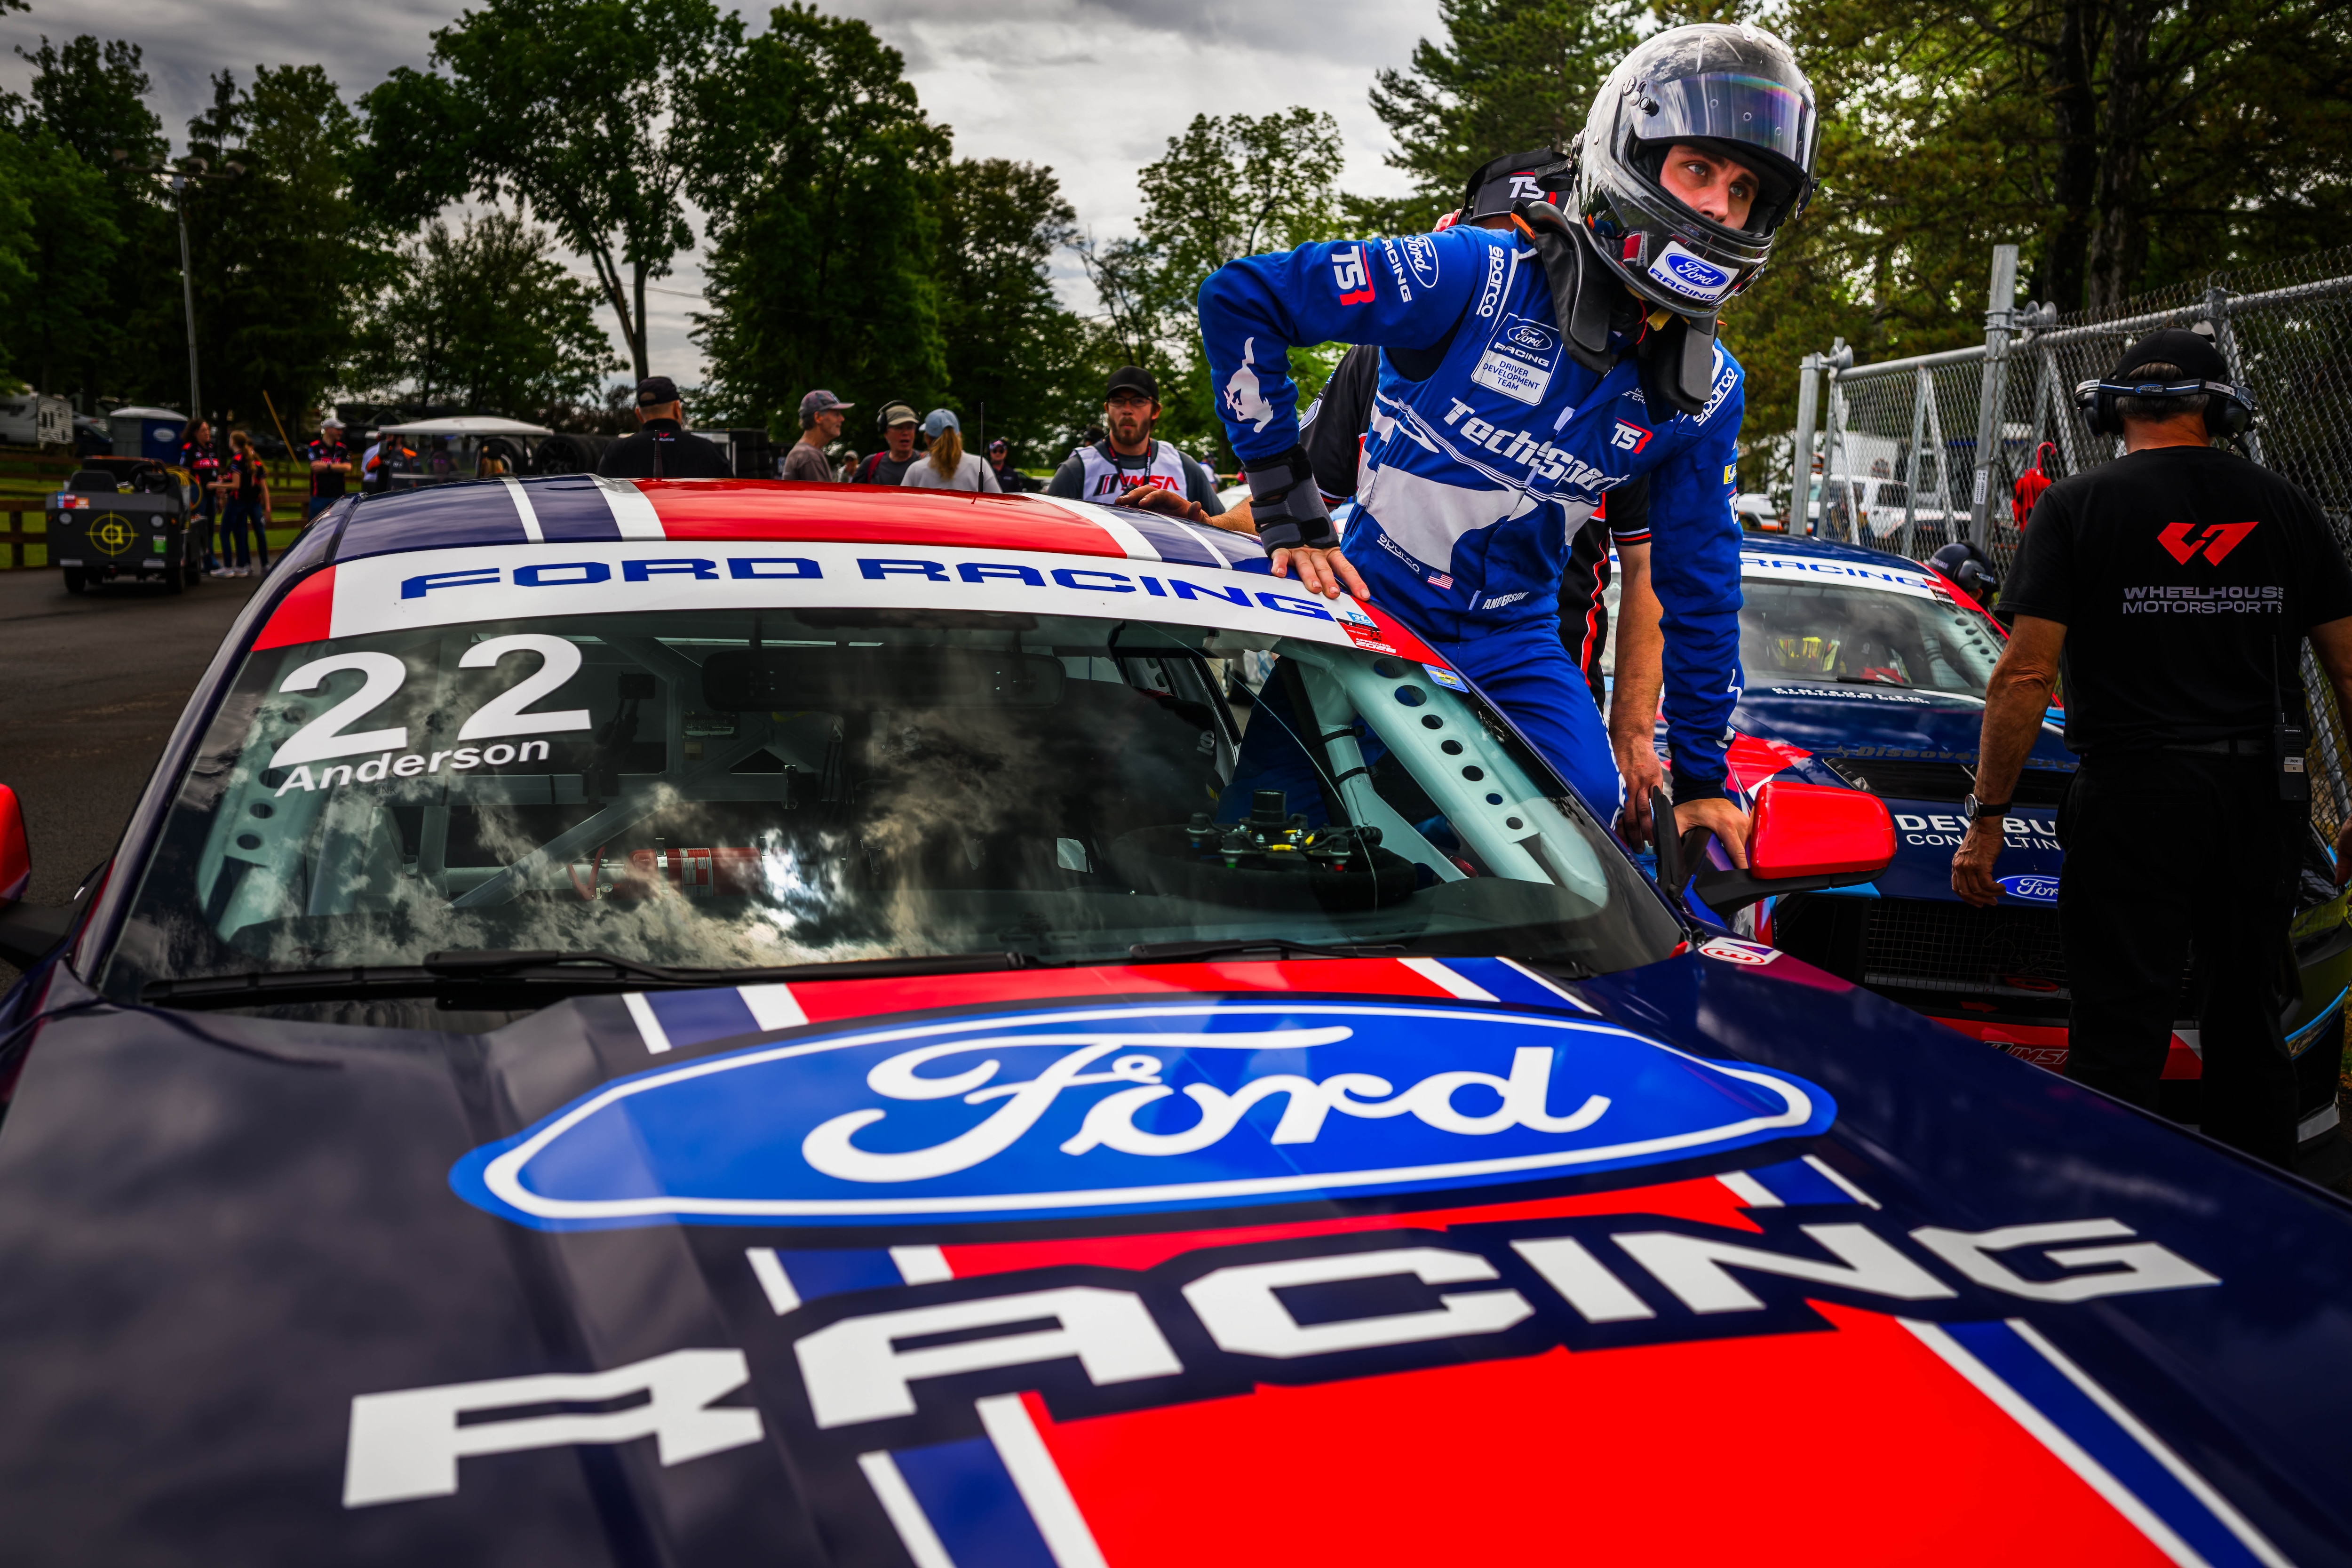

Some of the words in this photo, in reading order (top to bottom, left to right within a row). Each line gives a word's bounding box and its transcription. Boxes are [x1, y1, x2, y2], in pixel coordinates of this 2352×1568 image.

[1404, 236, 1433, 273] Ford
[1382, 239, 1412, 303] ACING
[1476, 244, 1504, 318] sparco
[1649, 267, 1718, 300] RACING
[1676, 261, 1718, 286] Ford
[1515, 328, 1544, 348] Ford
[1494, 342, 1550, 367] RACING
[1482, 363, 1540, 390] DEVELOPMENT
[1499, 360, 1529, 377] DRIVER
[1497, 377, 1519, 391] TEAM
[1376, 533, 1420, 574] sparco
[1741, 557, 1929, 589] RACING
[400, 557, 824, 600] FORD
[856, 558, 1336, 622] RACING
[1482, 591, 1529, 610] ANDERSON
[2123, 586, 2284, 599] WHEELHOUSE
[2122, 601, 2282, 614] MOTORSPORTS
[1356, 637, 1391, 648] APPROVED
[275, 740, 550, 797] Anderson
[1906, 834, 2062, 851] CONLTIN
[2017, 878, 2058, 897] For
[801, 1026, 1612, 1183] Ford
[343, 1218, 2223, 1508] RACING
